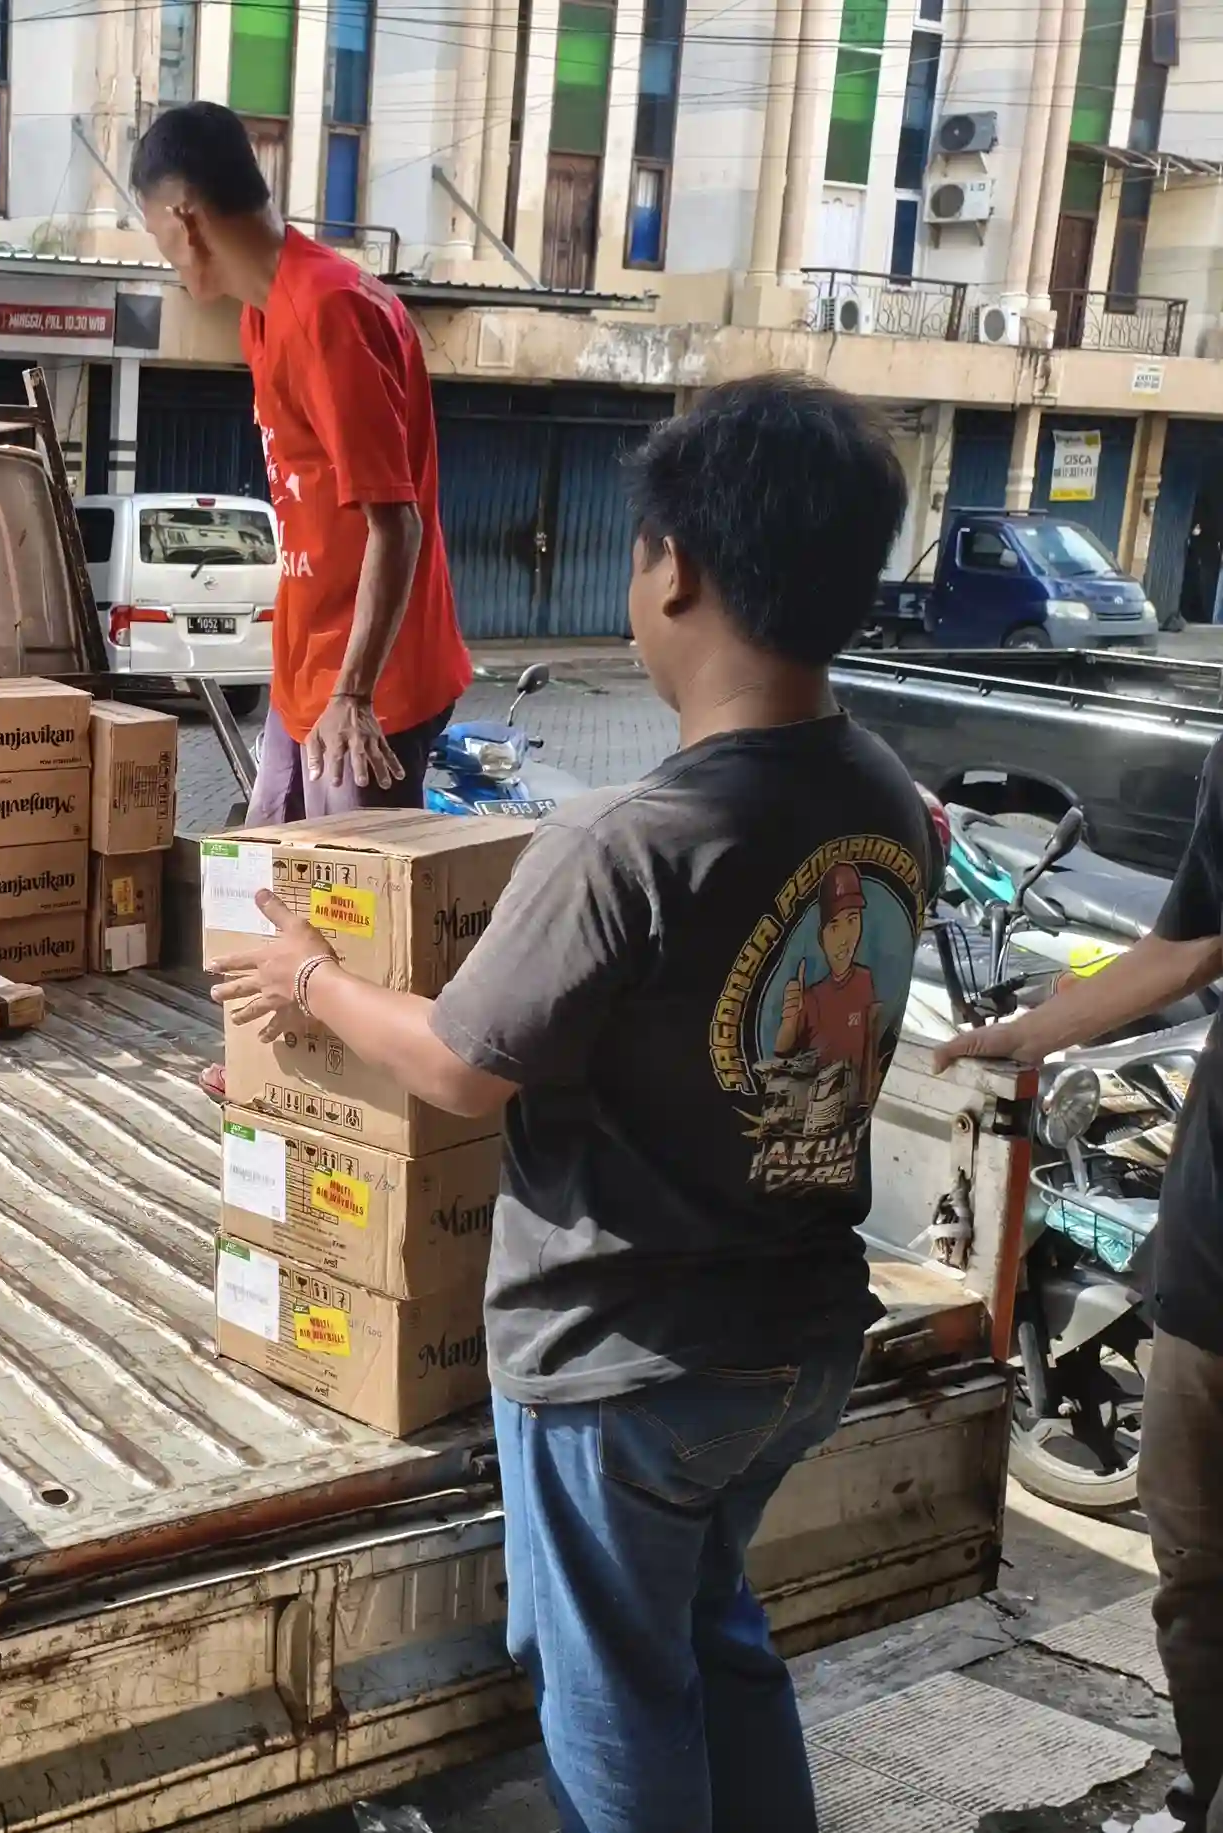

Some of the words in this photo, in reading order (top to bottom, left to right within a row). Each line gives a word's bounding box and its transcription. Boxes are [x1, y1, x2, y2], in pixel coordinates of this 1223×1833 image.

[315, 904, 329, 917] AIR
[330, 908, 370, 926] WAYBILLS
[710, 914, 784, 1096] JAGONYA
[775, 834, 923, 922] PENGIRIMAN
